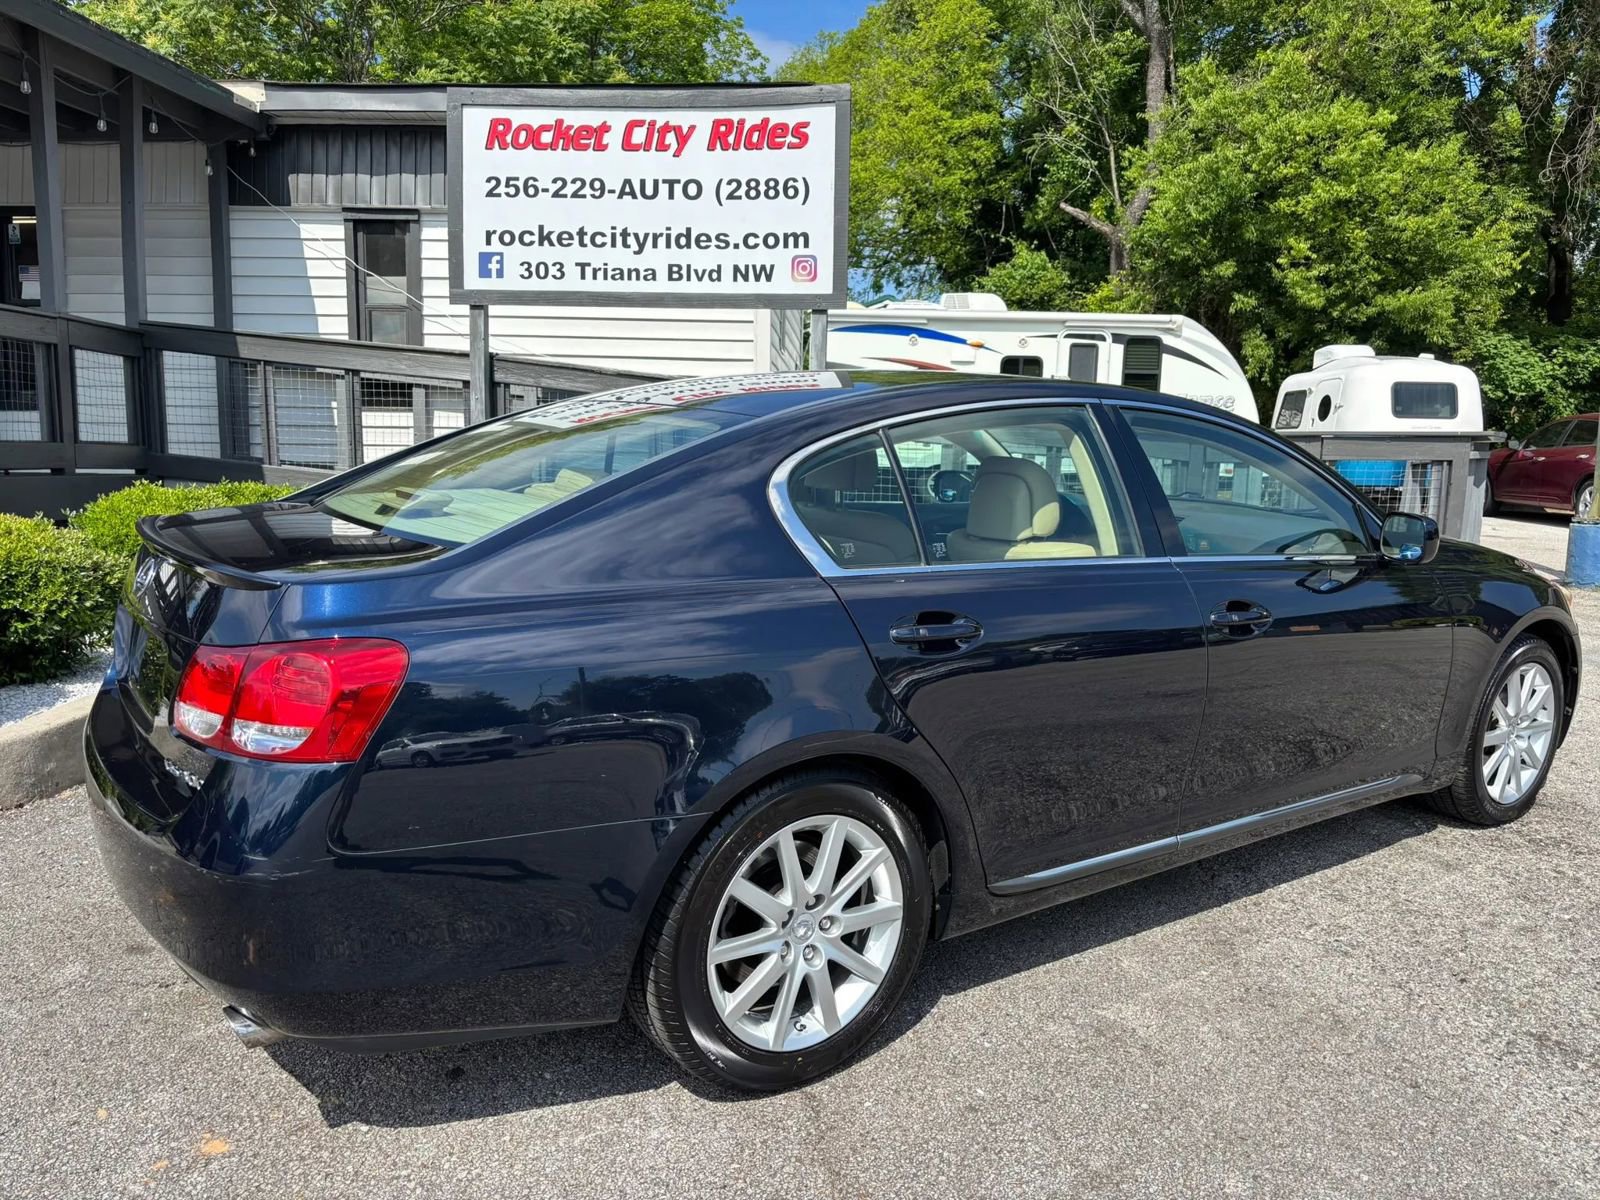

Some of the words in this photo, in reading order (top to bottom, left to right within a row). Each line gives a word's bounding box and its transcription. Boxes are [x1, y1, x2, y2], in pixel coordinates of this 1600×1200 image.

[485, 118, 611, 151] Rocket
[622, 120, 696, 157] City
[707, 118, 810, 151] Rides
[485, 176, 702, 200] 256-229-AUTO
[716, 177, 809, 206] (2886)
[485, 225, 809, 254] rocketcityrides.com
[520, 262, 565, 280] 303
[575, 263, 656, 281] Triana
[668, 264, 721, 282] Blvd
[733, 264, 774, 282] NW
